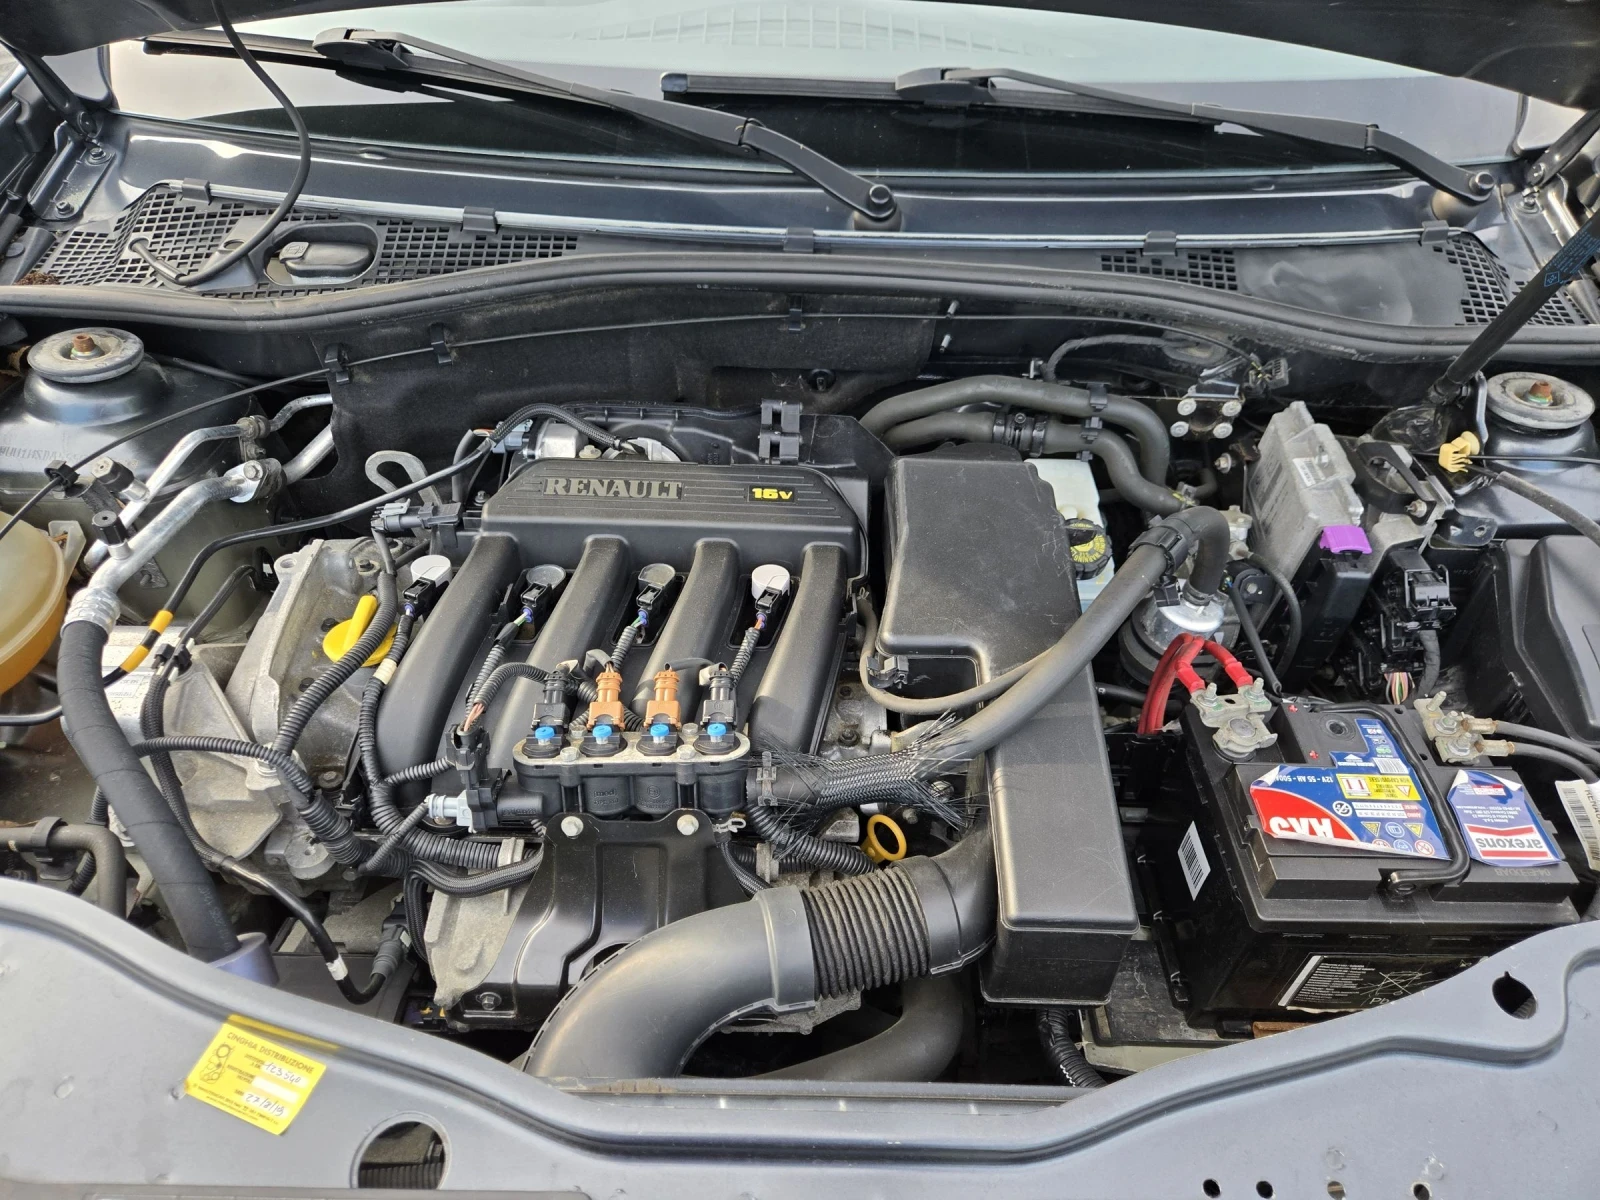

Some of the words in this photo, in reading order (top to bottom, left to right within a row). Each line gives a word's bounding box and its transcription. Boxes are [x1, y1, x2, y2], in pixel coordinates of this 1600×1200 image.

[544, 478, 682, 500] RENAULT
[1306, 775, 1316, 783] 55
[1475, 837, 1543, 851] arexons
[227, 1031, 258, 1050] CINGHIA
[258, 1045, 315, 1075] DISTRIBUZIONE
